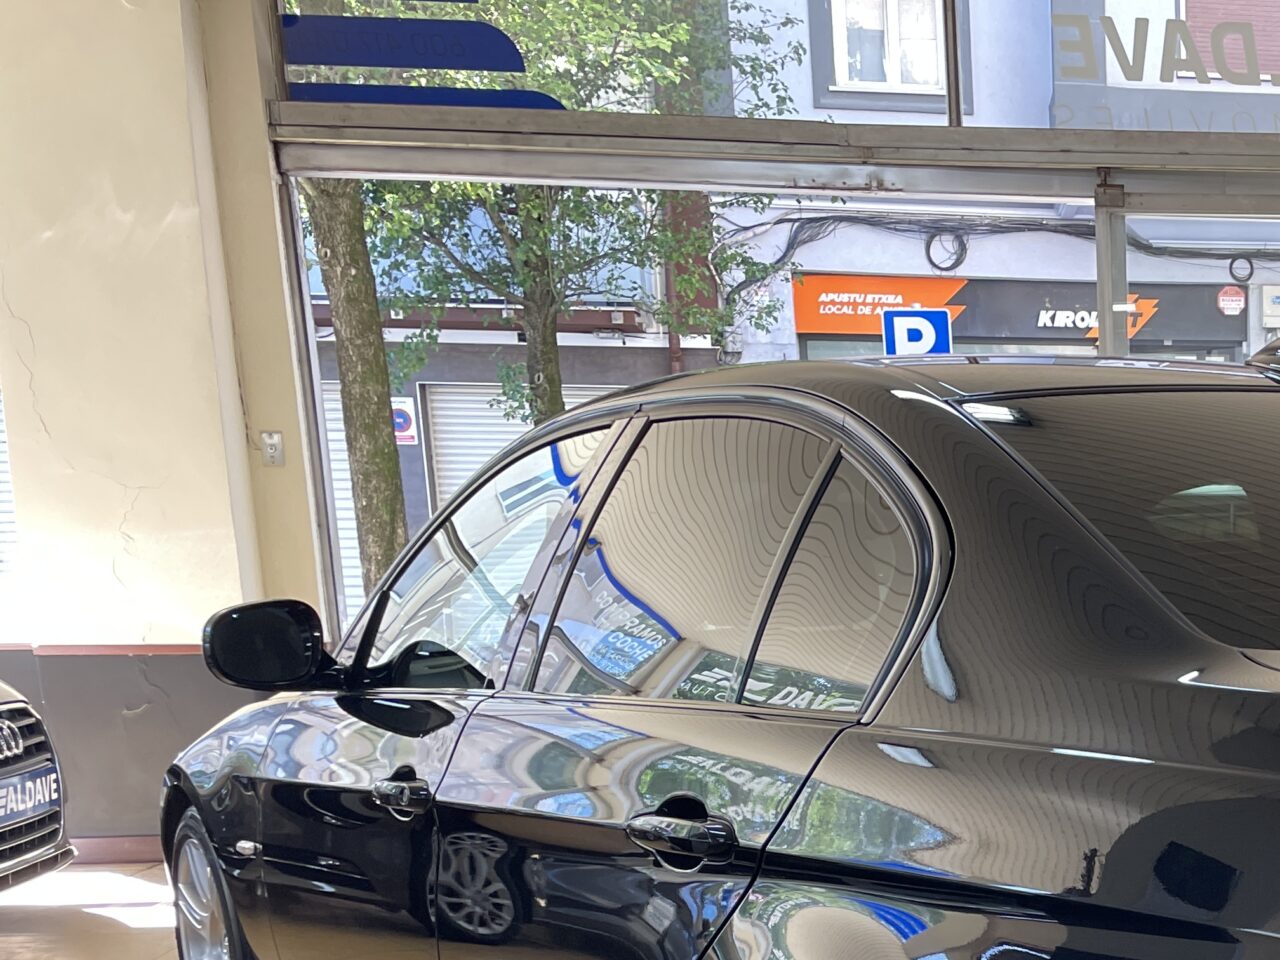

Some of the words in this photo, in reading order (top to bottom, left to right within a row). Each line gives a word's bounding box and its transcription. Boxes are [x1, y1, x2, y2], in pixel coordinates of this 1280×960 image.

[818, 293, 865, 303] APUSTU
[866, 294, 903, 304] ETXEA
[819, 305, 854, 315] LOCAL
[857, 307, 873, 315] DE
[893, 317, 936, 355] P
[607, 631, 654, 661] COCHE
[7, 772, 59, 815] ALDAVE
